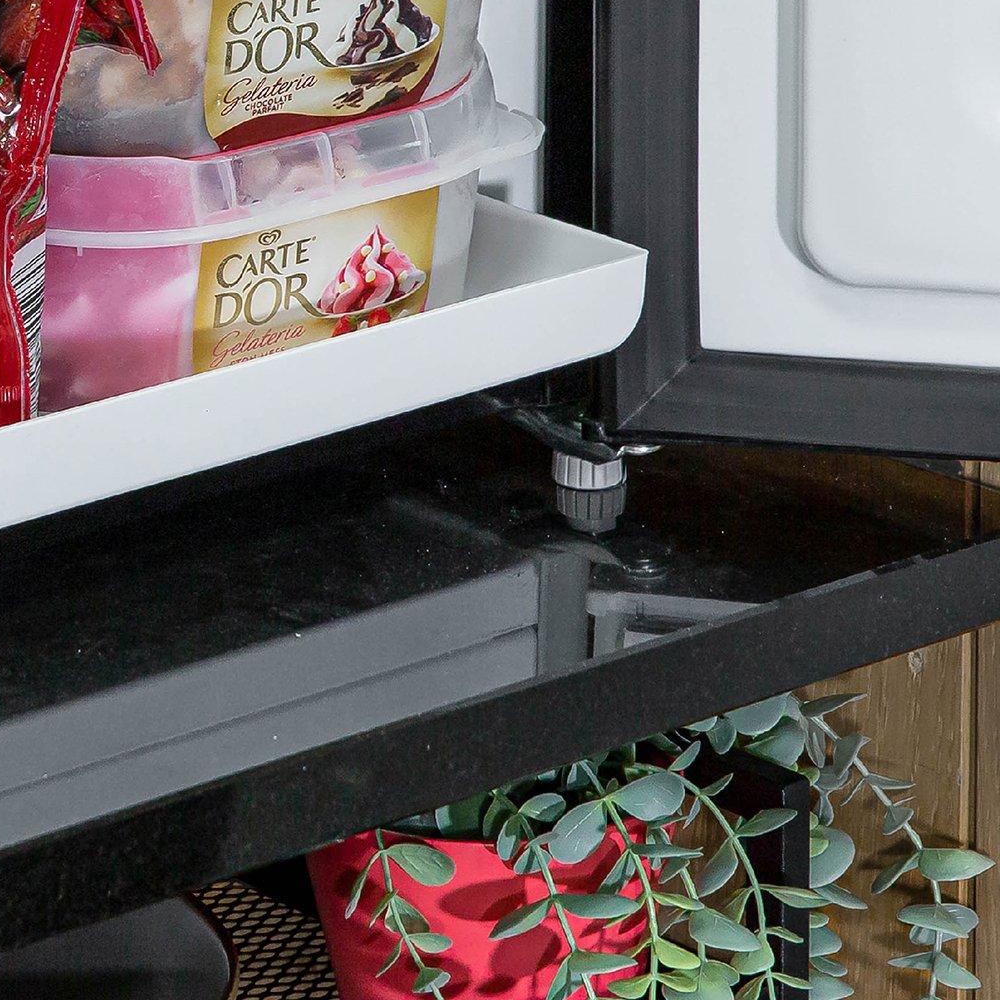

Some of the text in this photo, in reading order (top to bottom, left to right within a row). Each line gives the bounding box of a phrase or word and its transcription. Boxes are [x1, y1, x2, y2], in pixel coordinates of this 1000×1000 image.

[221, 73, 318, 116] Gelateria
[244, 93, 293, 112] CHOCOLATE
[252, 103, 286, 117] PARFAIT
[216, 238, 312, 288] CARTE
[210, 324, 307, 368] Gelateria
